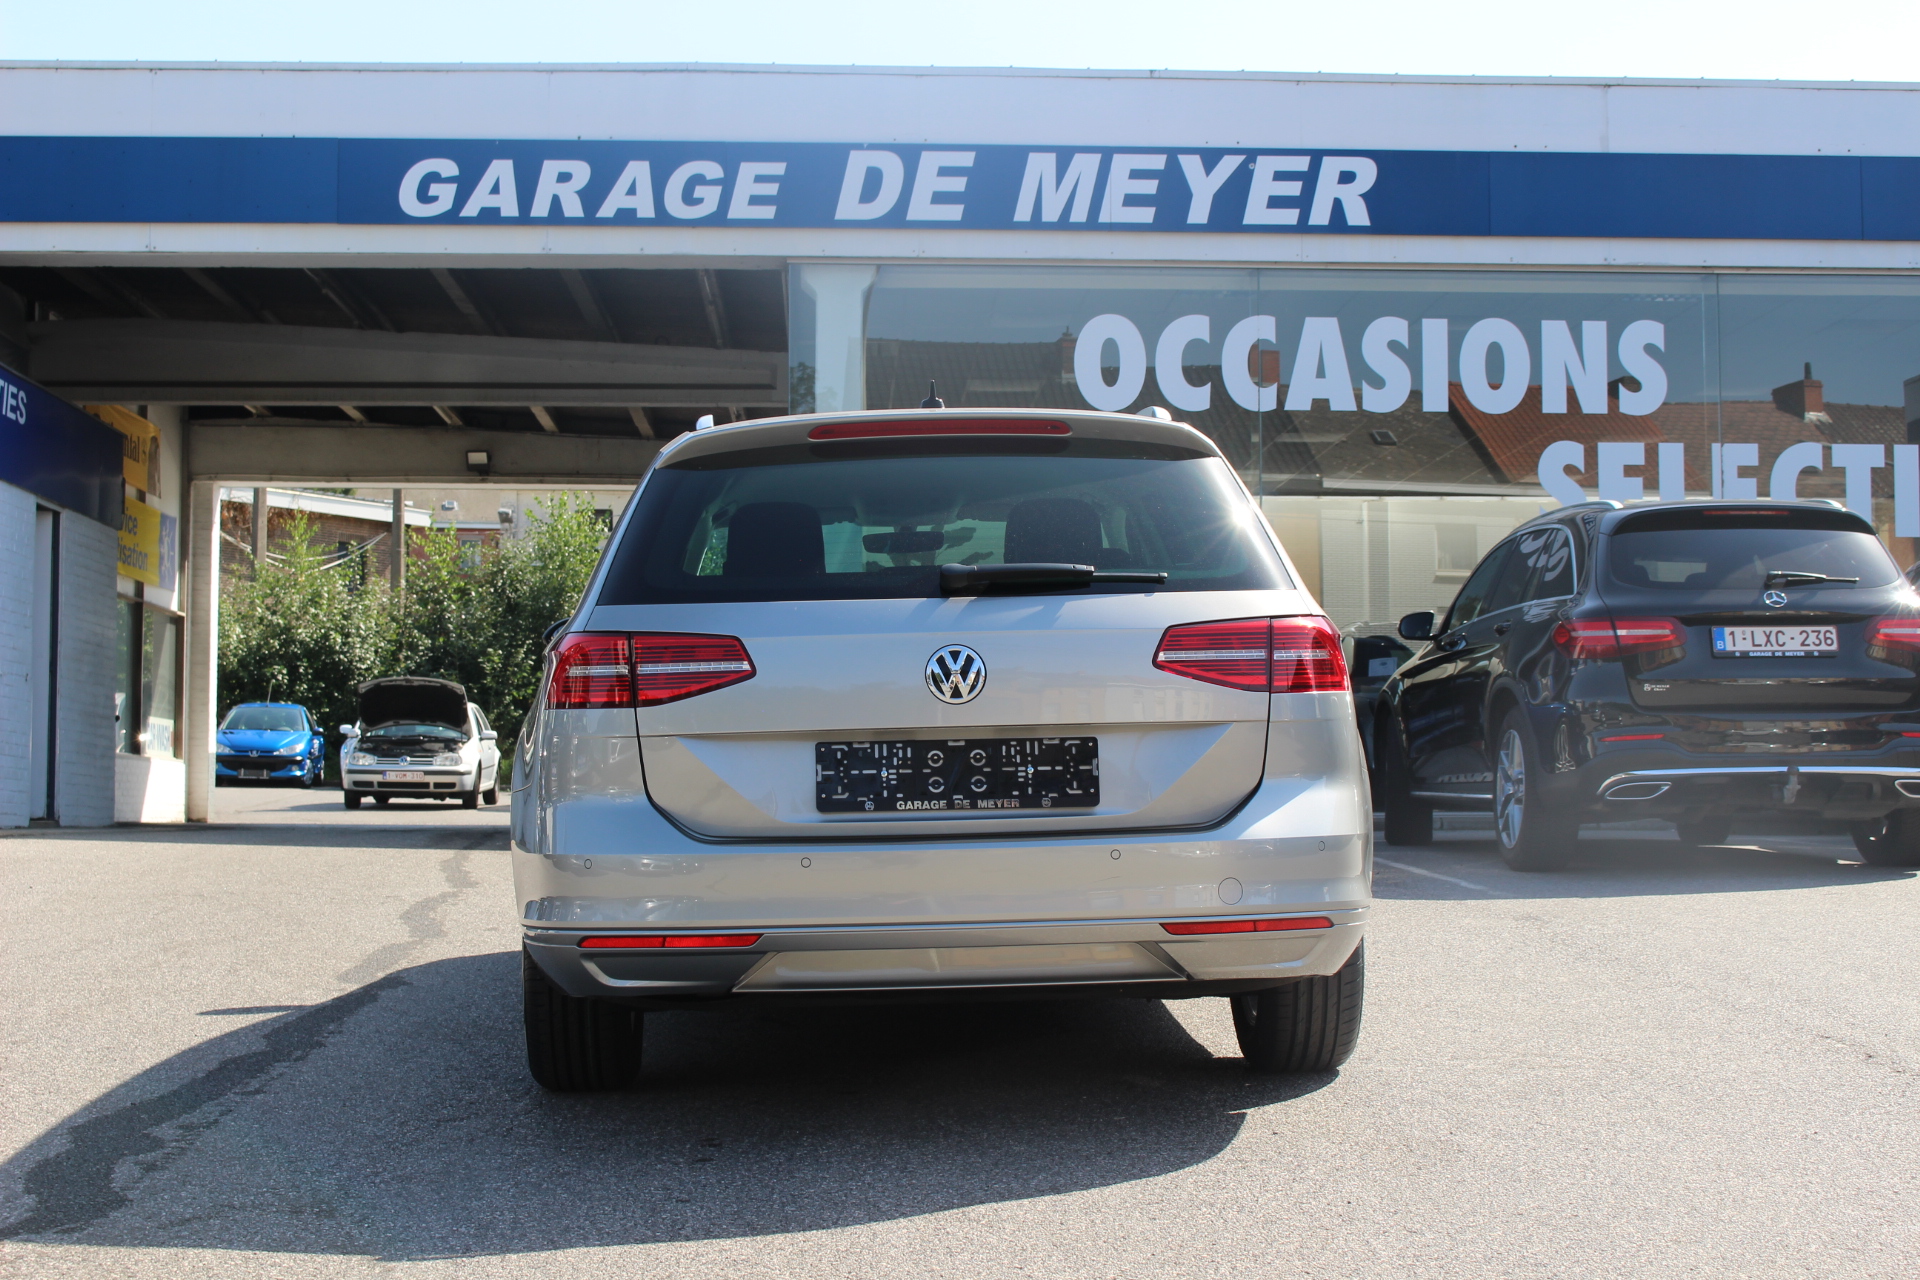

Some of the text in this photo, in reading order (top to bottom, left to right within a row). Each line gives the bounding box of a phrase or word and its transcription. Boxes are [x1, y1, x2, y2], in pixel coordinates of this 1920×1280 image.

[398, 149, 1378, 227] GARAGE DE MEYER
[1073, 313, 1669, 416] OCCASIONS
[896, 798, 1020, 811] GARAGE DE MEYER
